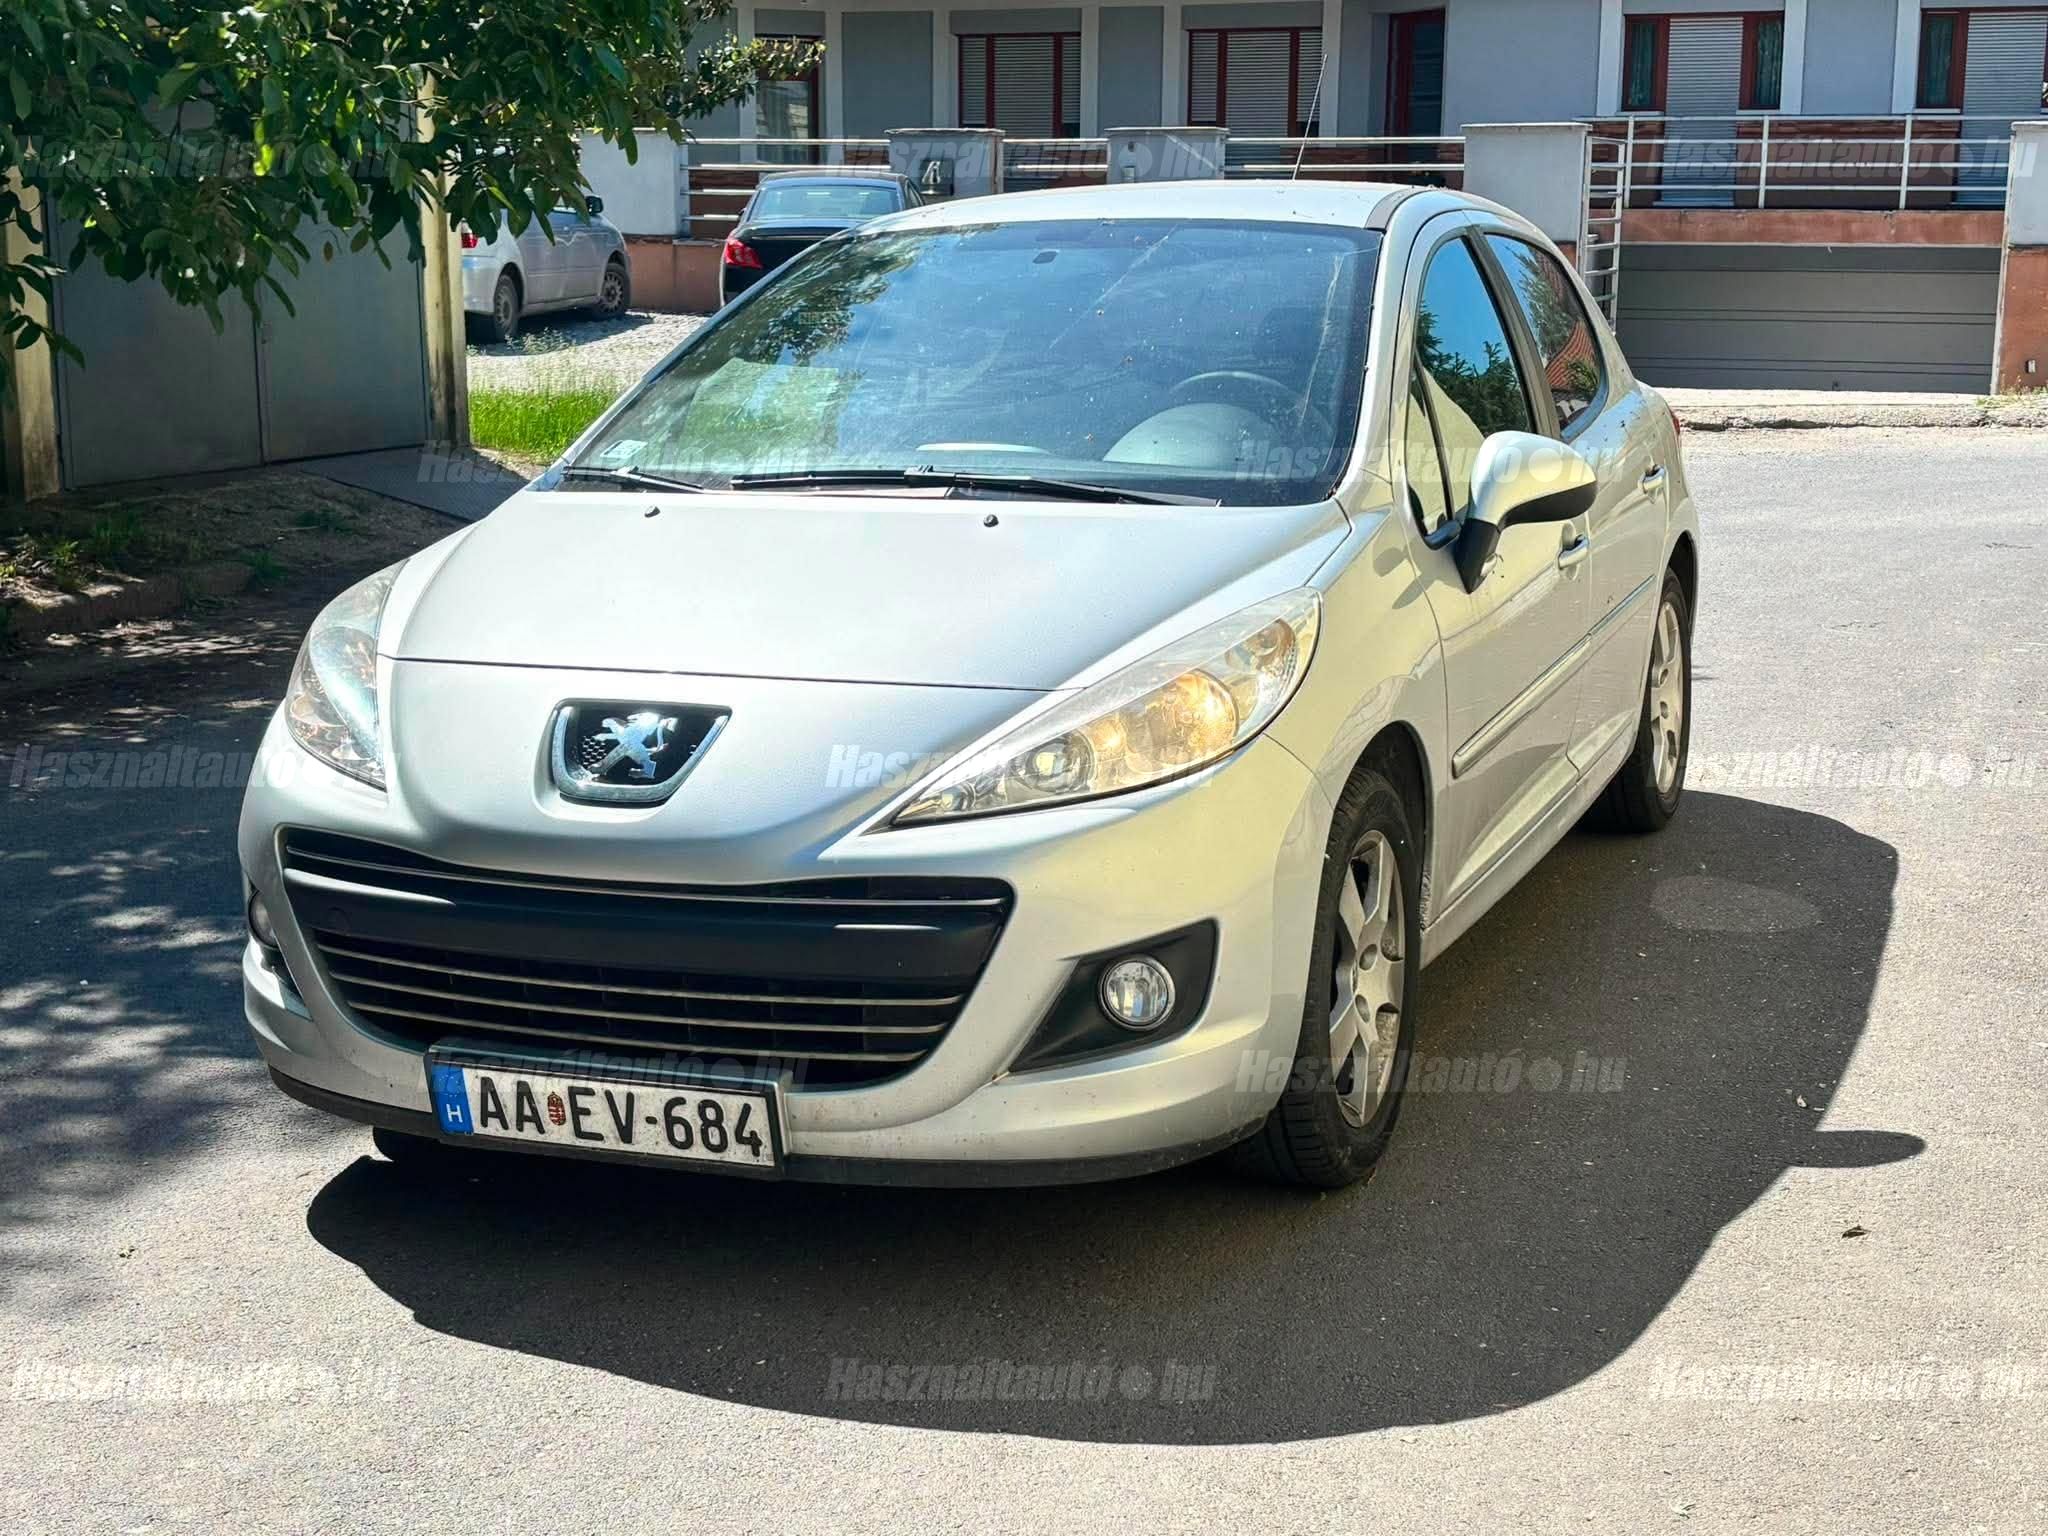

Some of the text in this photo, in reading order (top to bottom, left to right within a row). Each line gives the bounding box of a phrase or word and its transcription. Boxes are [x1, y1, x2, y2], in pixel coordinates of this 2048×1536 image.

[446, 1103, 463, 1123] H
[479, 1076, 763, 1158] AA EV-684
